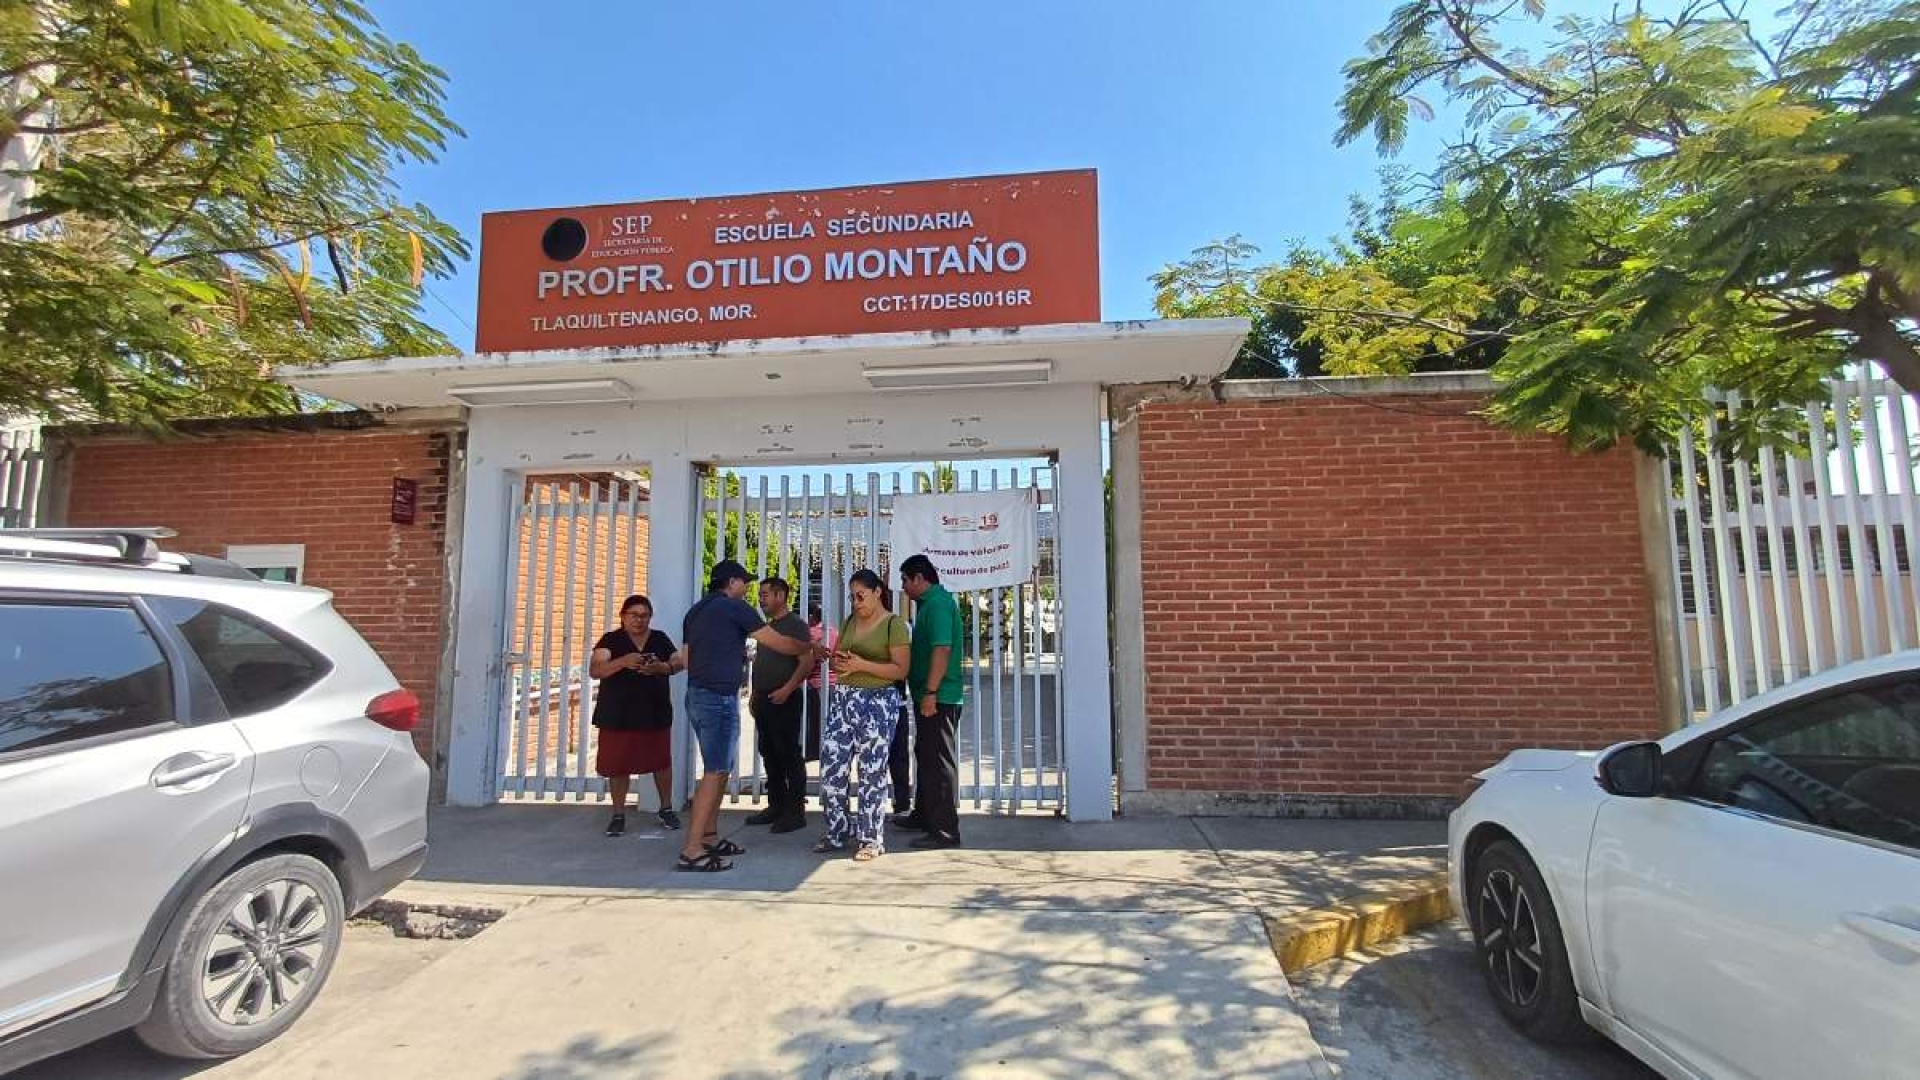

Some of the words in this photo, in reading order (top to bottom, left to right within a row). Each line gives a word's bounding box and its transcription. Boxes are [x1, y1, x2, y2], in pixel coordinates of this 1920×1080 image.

[611, 215, 653, 236] SEP
[714, 221, 816, 244] ESCUELA
[827, 210, 974, 236] SECUNDARIA
[537, 263, 673, 300] PROFR.
[685, 253, 813, 290] OTILIO
[824, 236, 1027, 282] MONTAÑO
[863, 289, 1033, 313] CCT:17DES0016R
[532, 308, 703, 332] TLAQUILTENANGO,
[709, 304, 757, 322] MOR.
